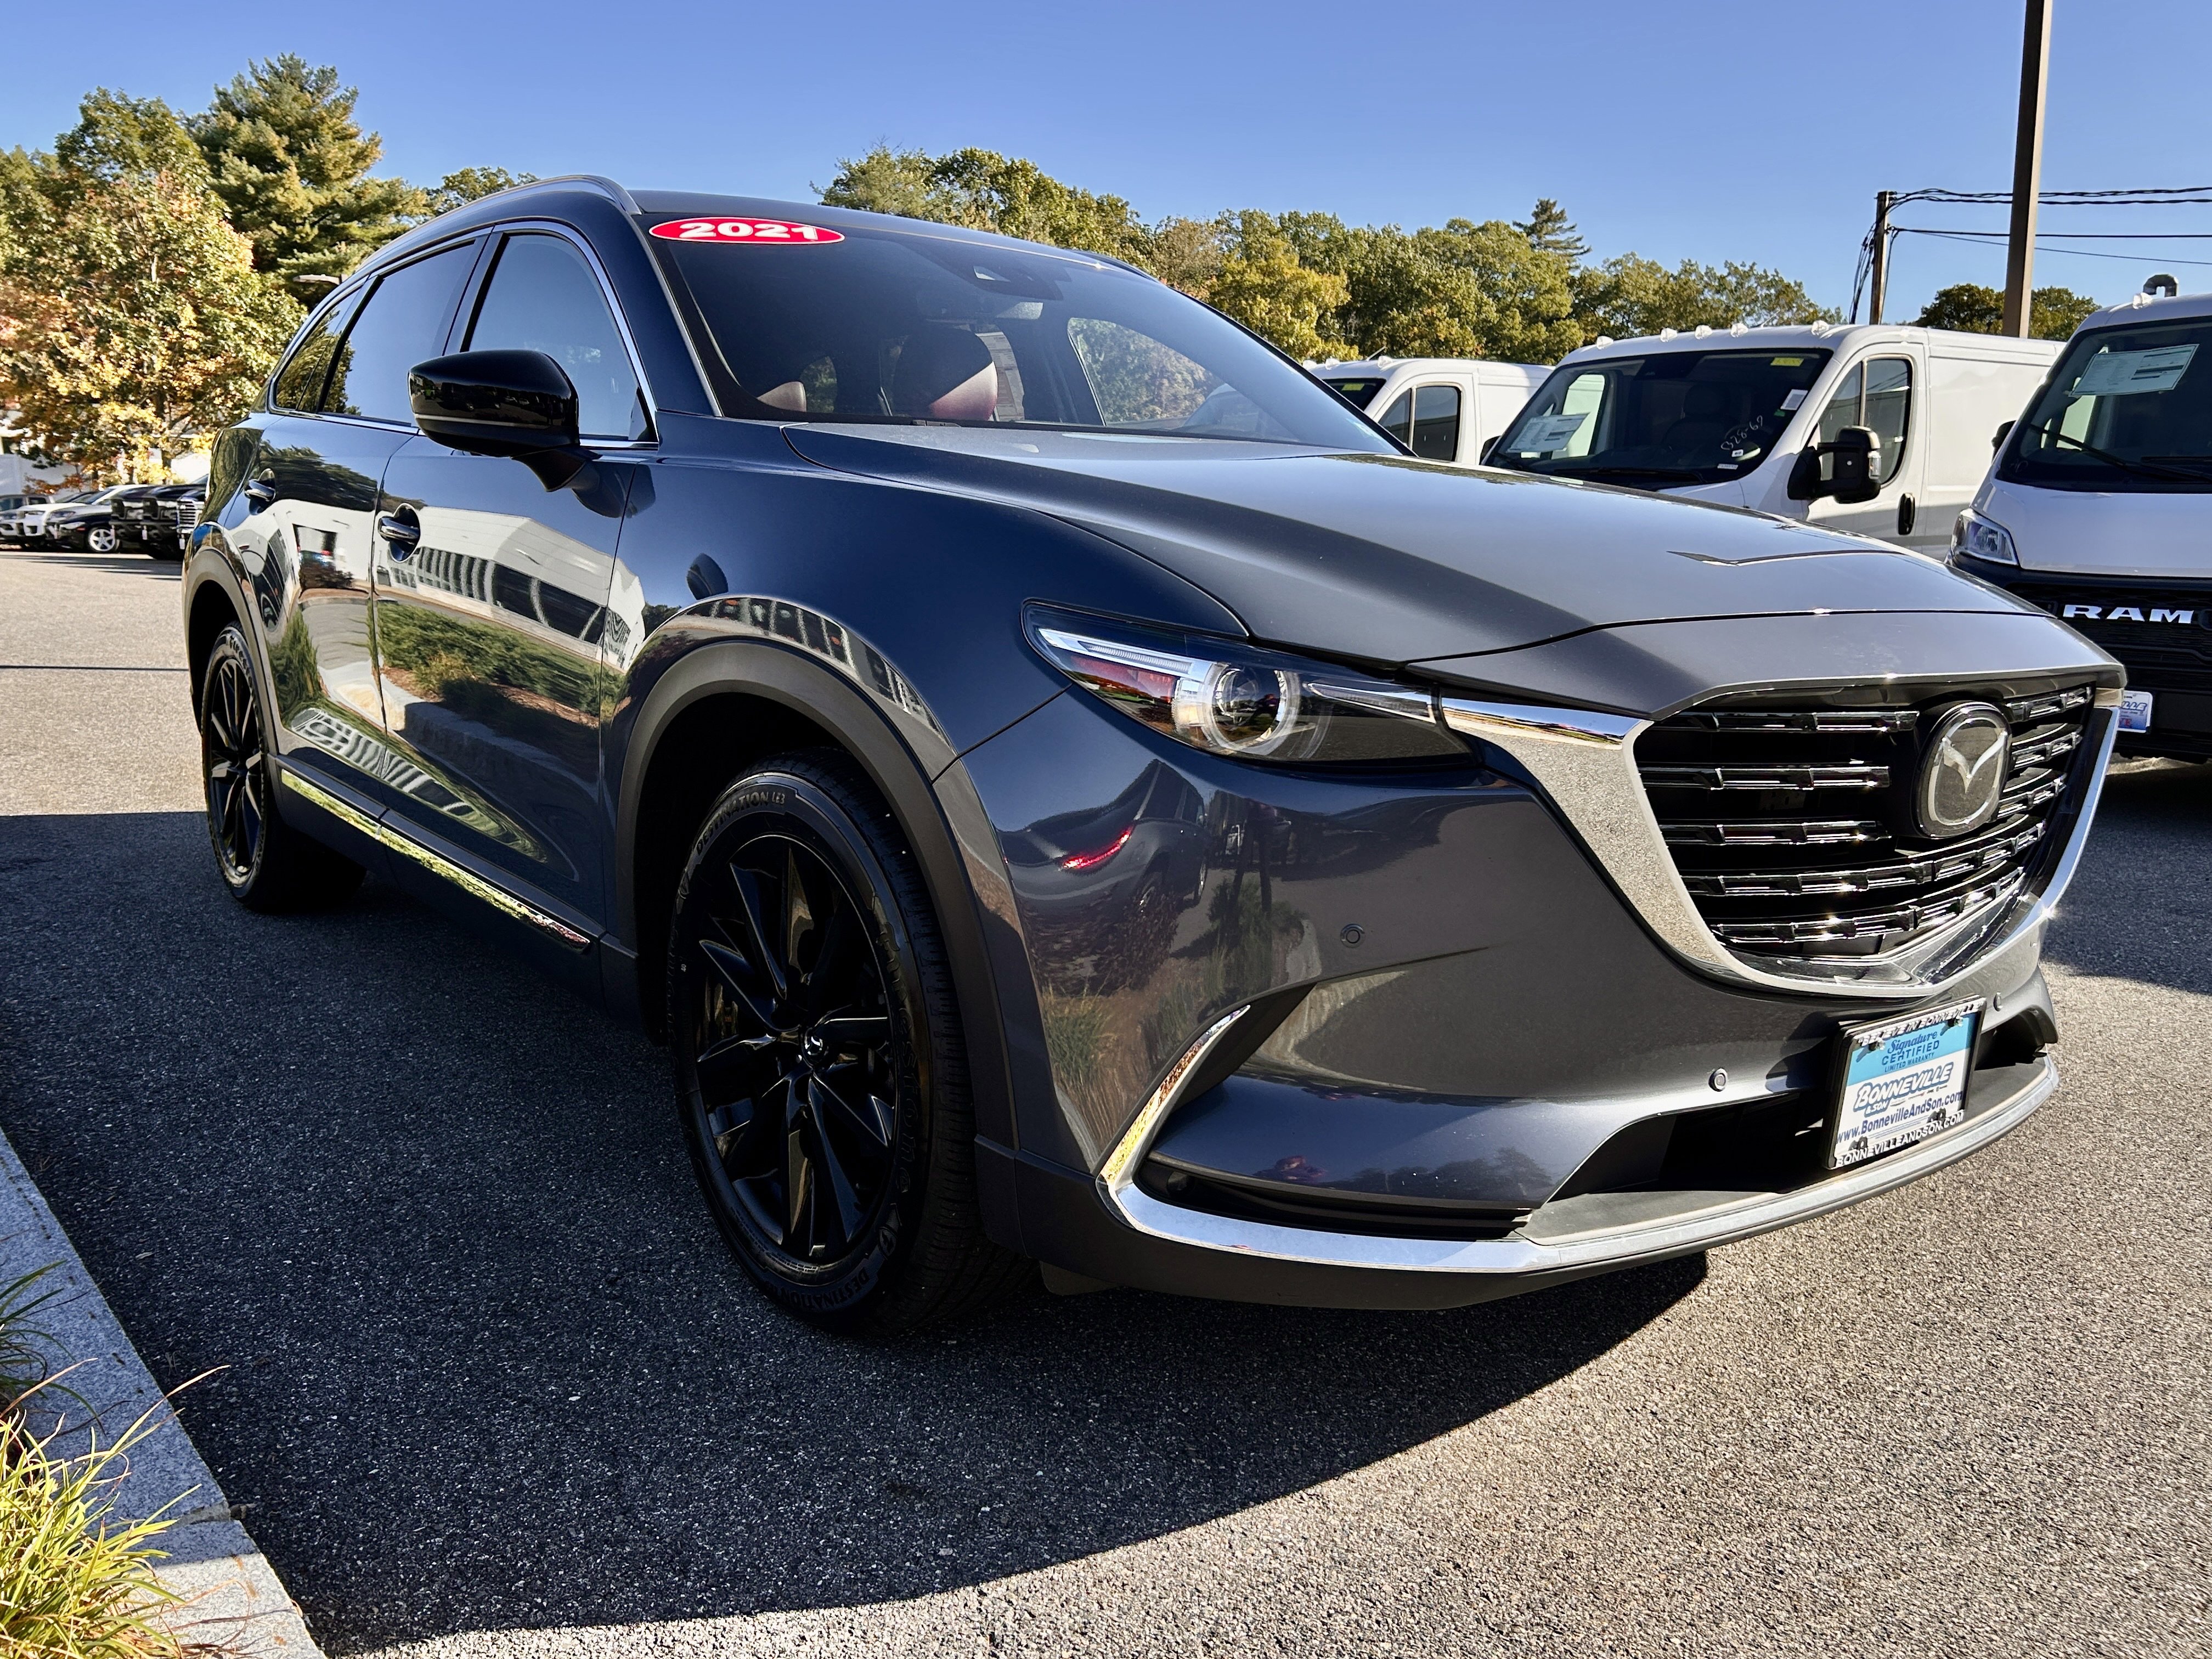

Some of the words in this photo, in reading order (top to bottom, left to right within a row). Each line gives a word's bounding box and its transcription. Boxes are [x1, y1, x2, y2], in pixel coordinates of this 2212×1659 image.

[679, 222, 819, 241] 2021
[2063, 604, 2194, 624] RAM
[696, 791, 770, 855] DESTINATION
[1881, 1040, 1940, 1065] CERTIFIED
[1887, 1030, 1938, 1054] Signature
[1884, 1060, 1906, 1073] LIMITED
[1907, 1051, 1936, 1066] WARRANTY
[1853, 1062, 1954, 1112] BONNEVILLE
[1836, 1090, 1963, 1144] www.BonnevilleAndSon.com
[1836, 1110, 1965, 1167] BONNEVILLEANDSON.COM
